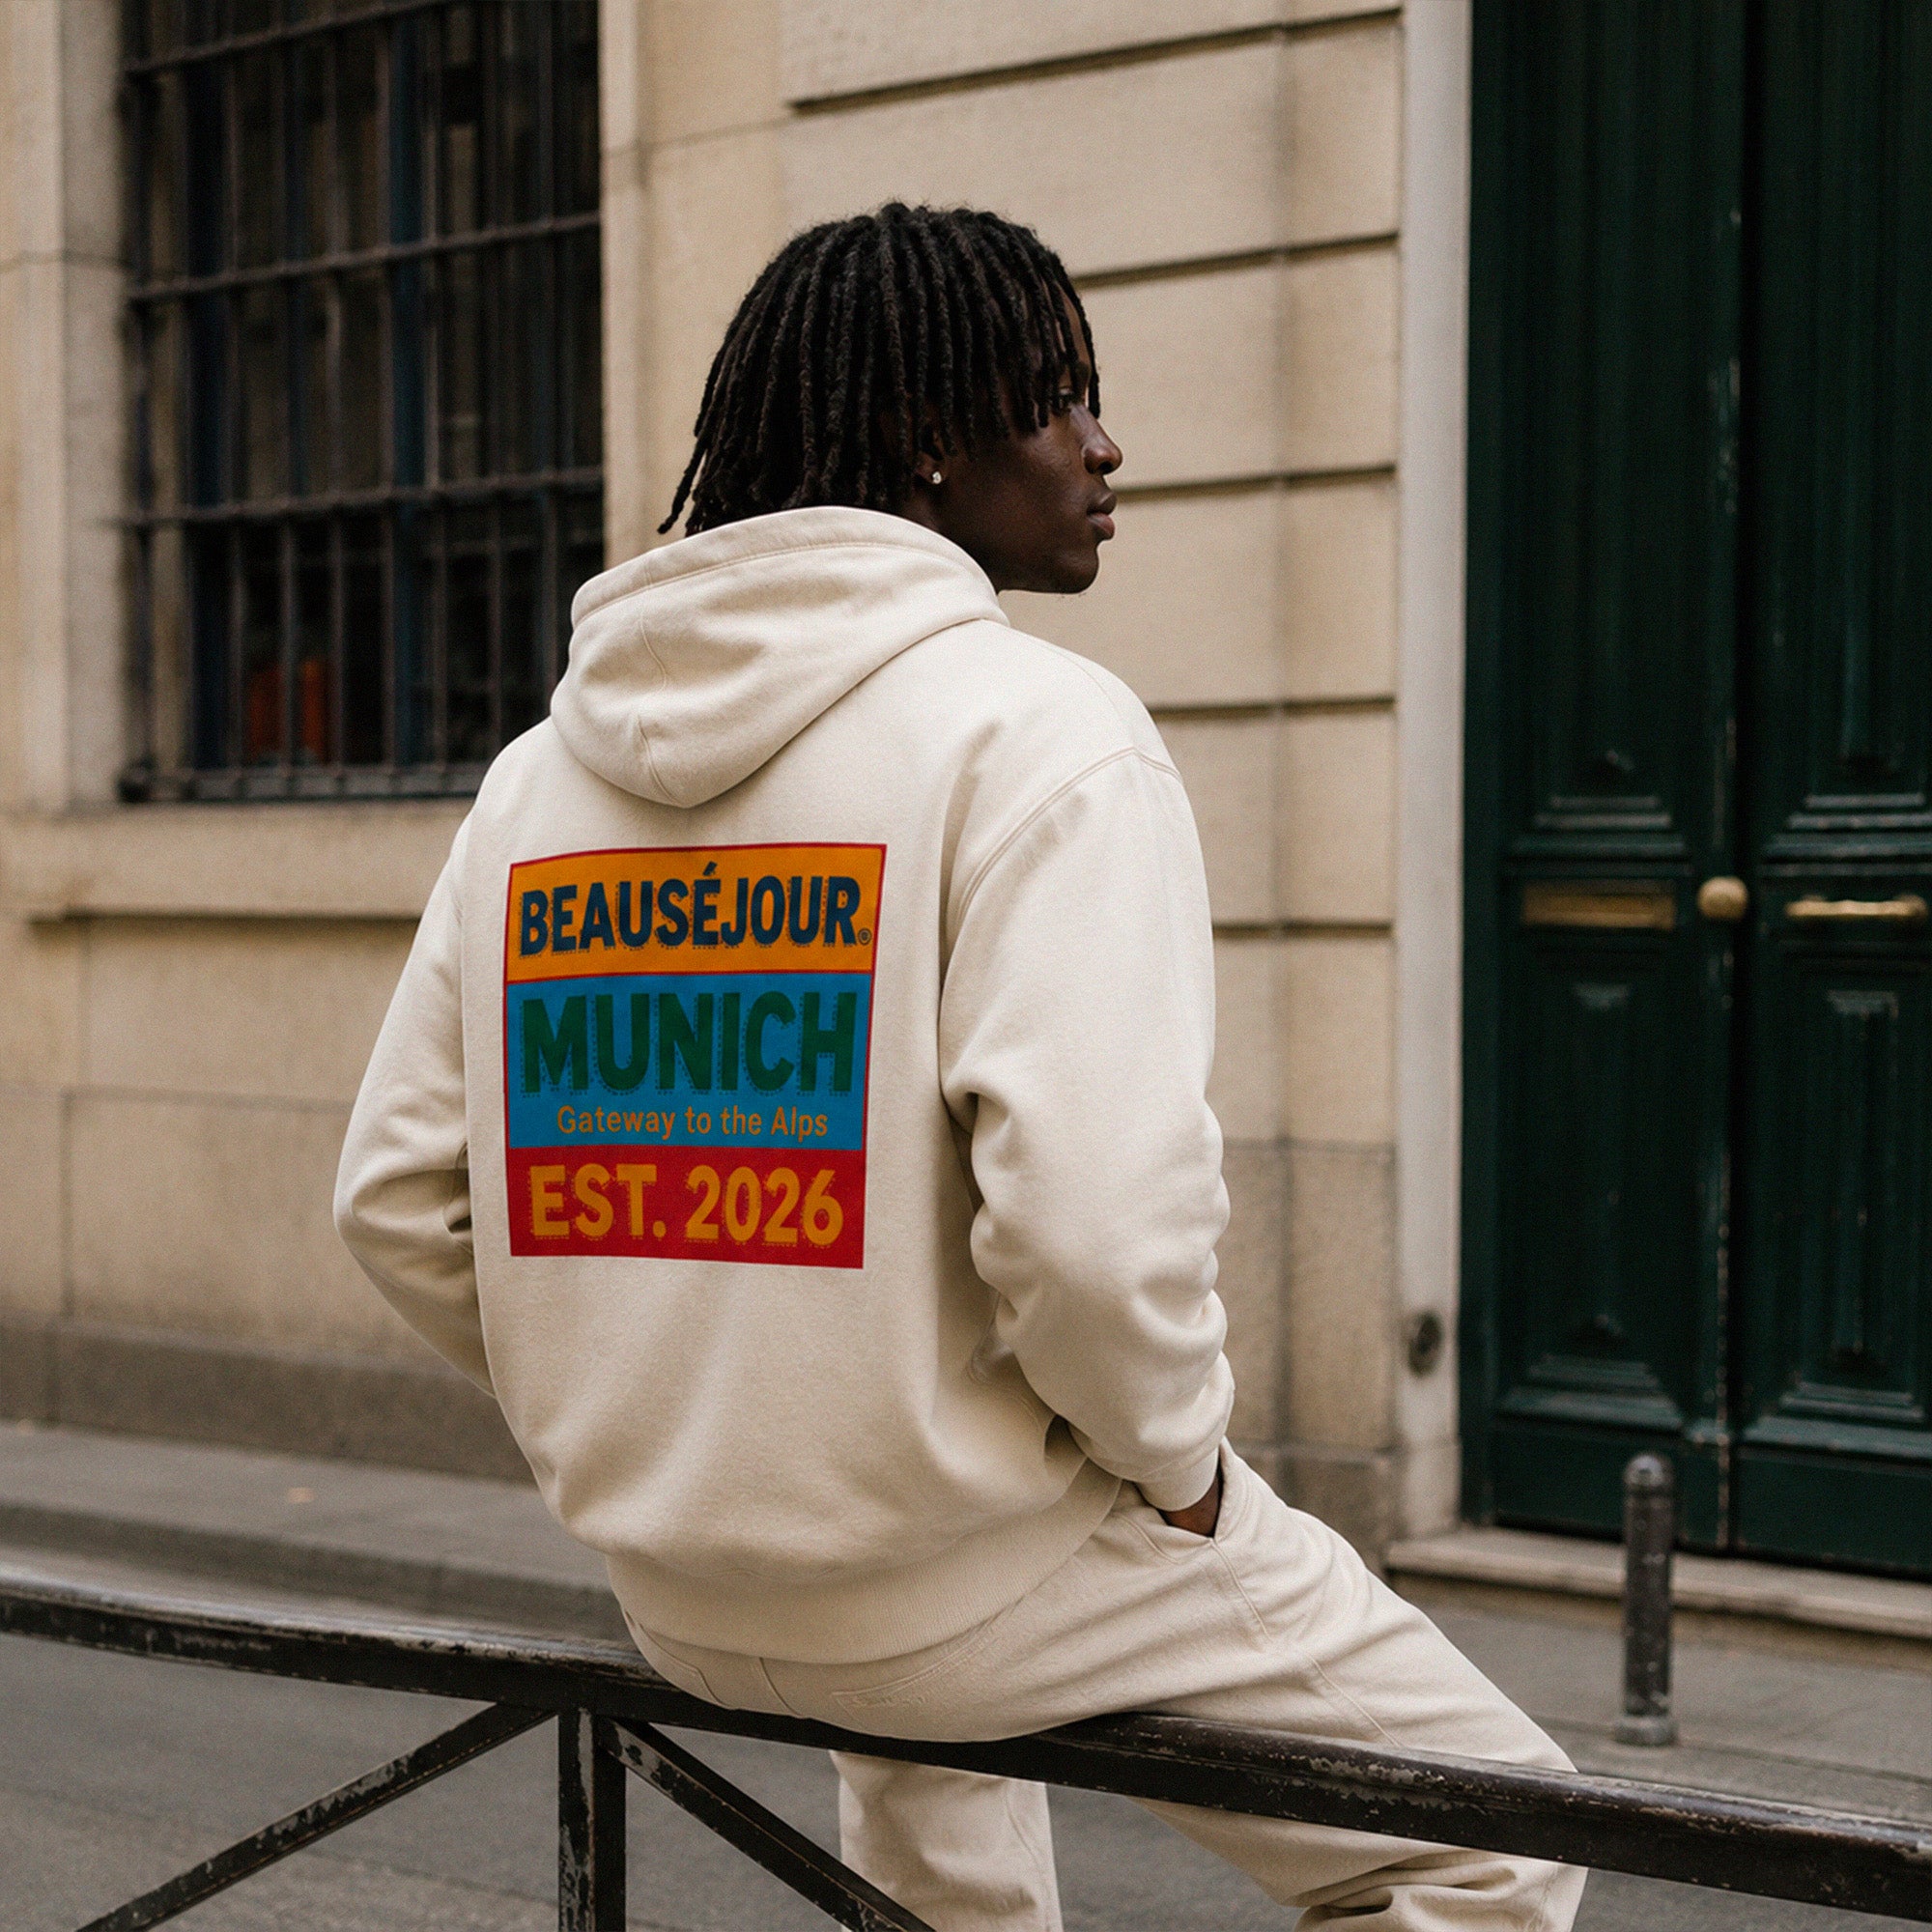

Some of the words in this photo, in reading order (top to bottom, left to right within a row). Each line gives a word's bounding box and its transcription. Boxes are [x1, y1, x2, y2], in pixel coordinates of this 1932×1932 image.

[522, 991, 857, 1095] MUNICH
[556, 1105, 675, 1140] Gateway
[685, 1108, 712, 1134] to
[720, 1106, 762, 1135] the
[770, 1106, 828, 1142] Alps
[529, 1163, 667, 1238] EST.
[684, 1165, 843, 1246] 2026
